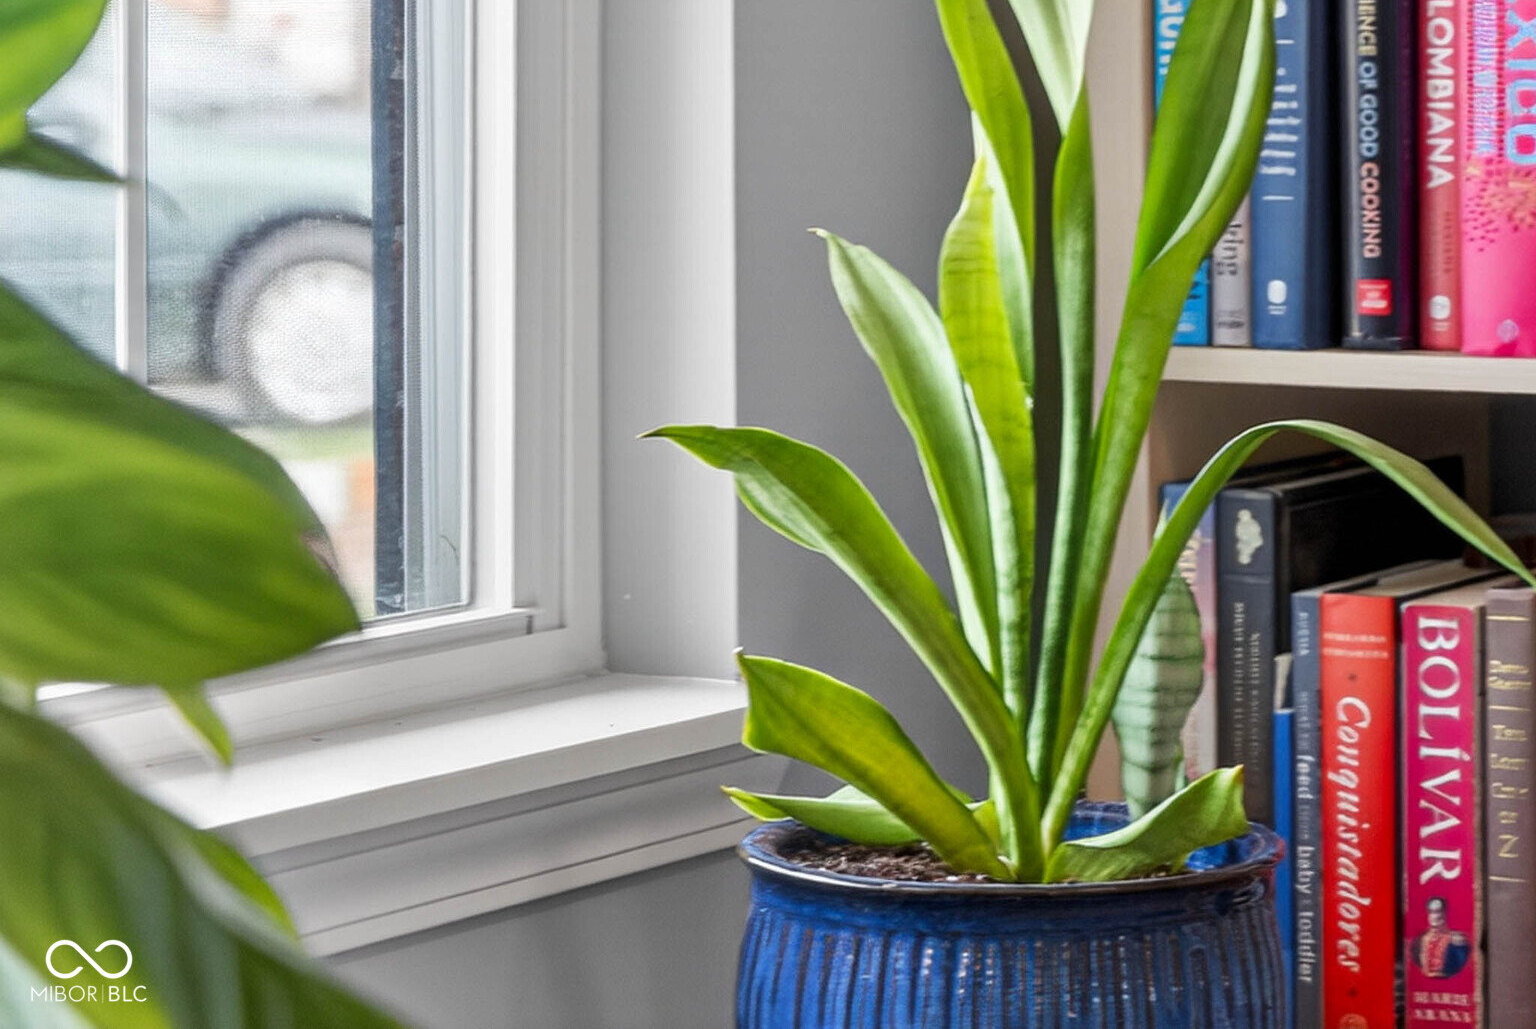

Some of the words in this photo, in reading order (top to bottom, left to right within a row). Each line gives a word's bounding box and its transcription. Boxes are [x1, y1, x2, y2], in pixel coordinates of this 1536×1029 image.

[1359, 61, 1379, 89] OF
[1360, 94, 1379, 158] GOOD
[1360, 162, 1382, 258] COOKING
[1418, 616, 1471, 885] BOLÍVAR
[1327, 696, 1372, 973] Conquistadores
[1498, 835, 1519, 858] Z
[1295, 845, 1316, 894] baby
[1297, 911, 1316, 984] toddler
